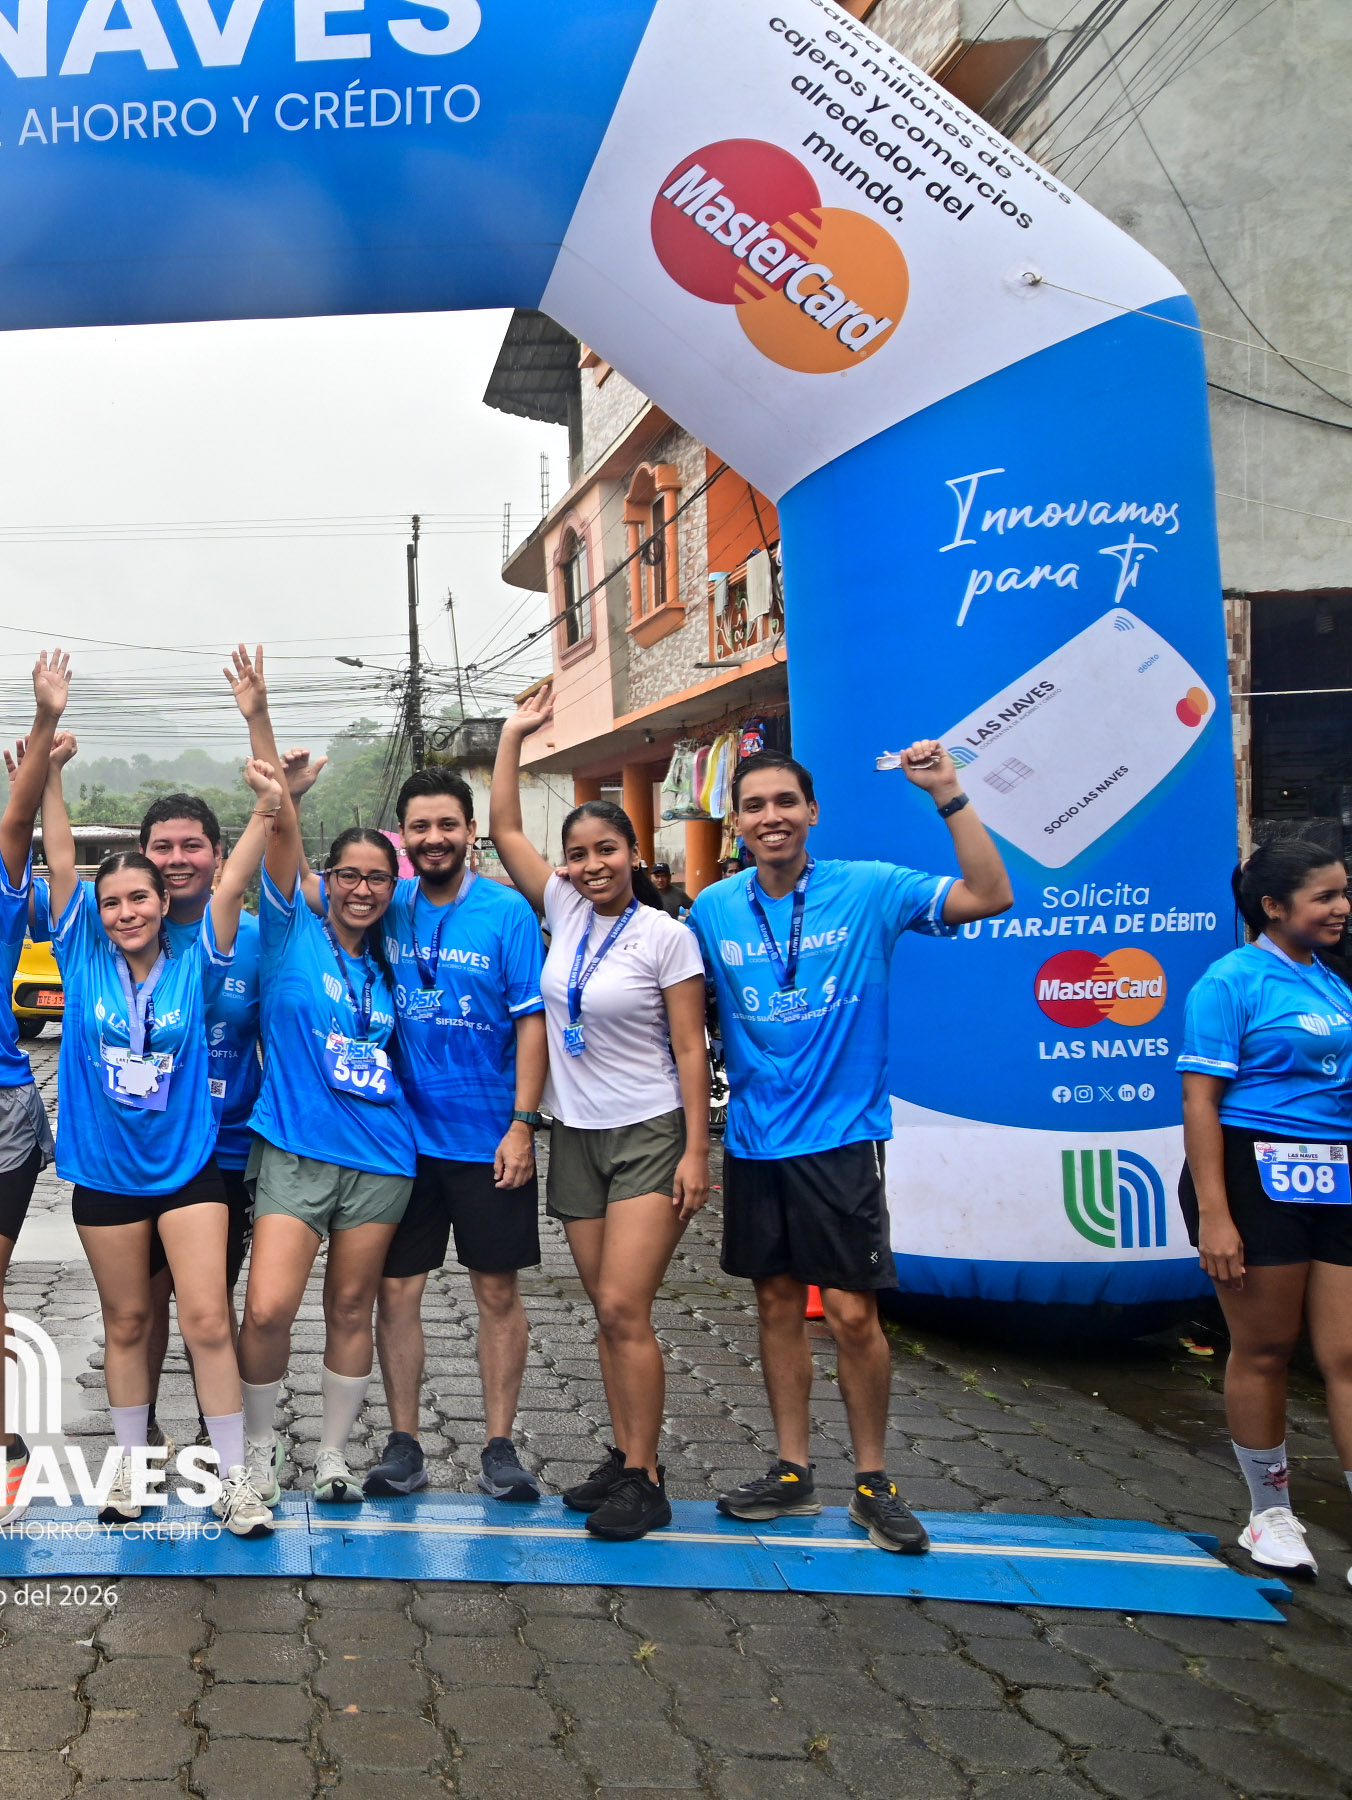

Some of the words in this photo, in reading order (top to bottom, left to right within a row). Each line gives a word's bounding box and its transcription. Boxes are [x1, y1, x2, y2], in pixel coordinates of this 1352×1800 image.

[19, 97, 217, 146] AHORRO
[232, 95, 261, 134] Y
[274, 79, 481, 131] CRÉDITO
[769, 17, 867, 97] cajeros
[865, 94, 891, 114] y
[891, 113, 1033, 229] comercios
[811, 0, 882, 53] ealiza
[888, 55, 1072, 205] transacciones
[825, 29, 858, 58] en
[861, 57, 973, 149] millones
[978, 149, 1012, 179] de
[791, 75, 926, 181] alrededor
[925, 181, 975, 221] del
[802, 131, 904, 223] mundo.
[661, 164, 894, 352] MasterCard
[939, 468, 1179, 553] Innovamos
[957, 563, 1080, 627] para
[1137, 653, 1160, 675] débito
[966, 720, 1001, 746] LAS
[998, 680, 1055, 722] NAVES
[1044, 806, 1079, 835] SOCIO
[1077, 791, 1098, 808] LAS
[1096, 765, 1129, 793] NAVES
[989, 915, 1108, 938] TARJETA
[1114, 913, 1148, 933] DE
[1150, 906, 1217, 932] DÉBITO
[1042, 882, 1150, 909] Solicita
[438, 948, 491, 969] NAVES
[1038, 976, 1163, 1001] MasterCard
[1039, 1040, 1086, 1060] LAS
[1091, 1038, 1169, 1058] NAVES
[1271, 1164, 1335, 1194] 508
